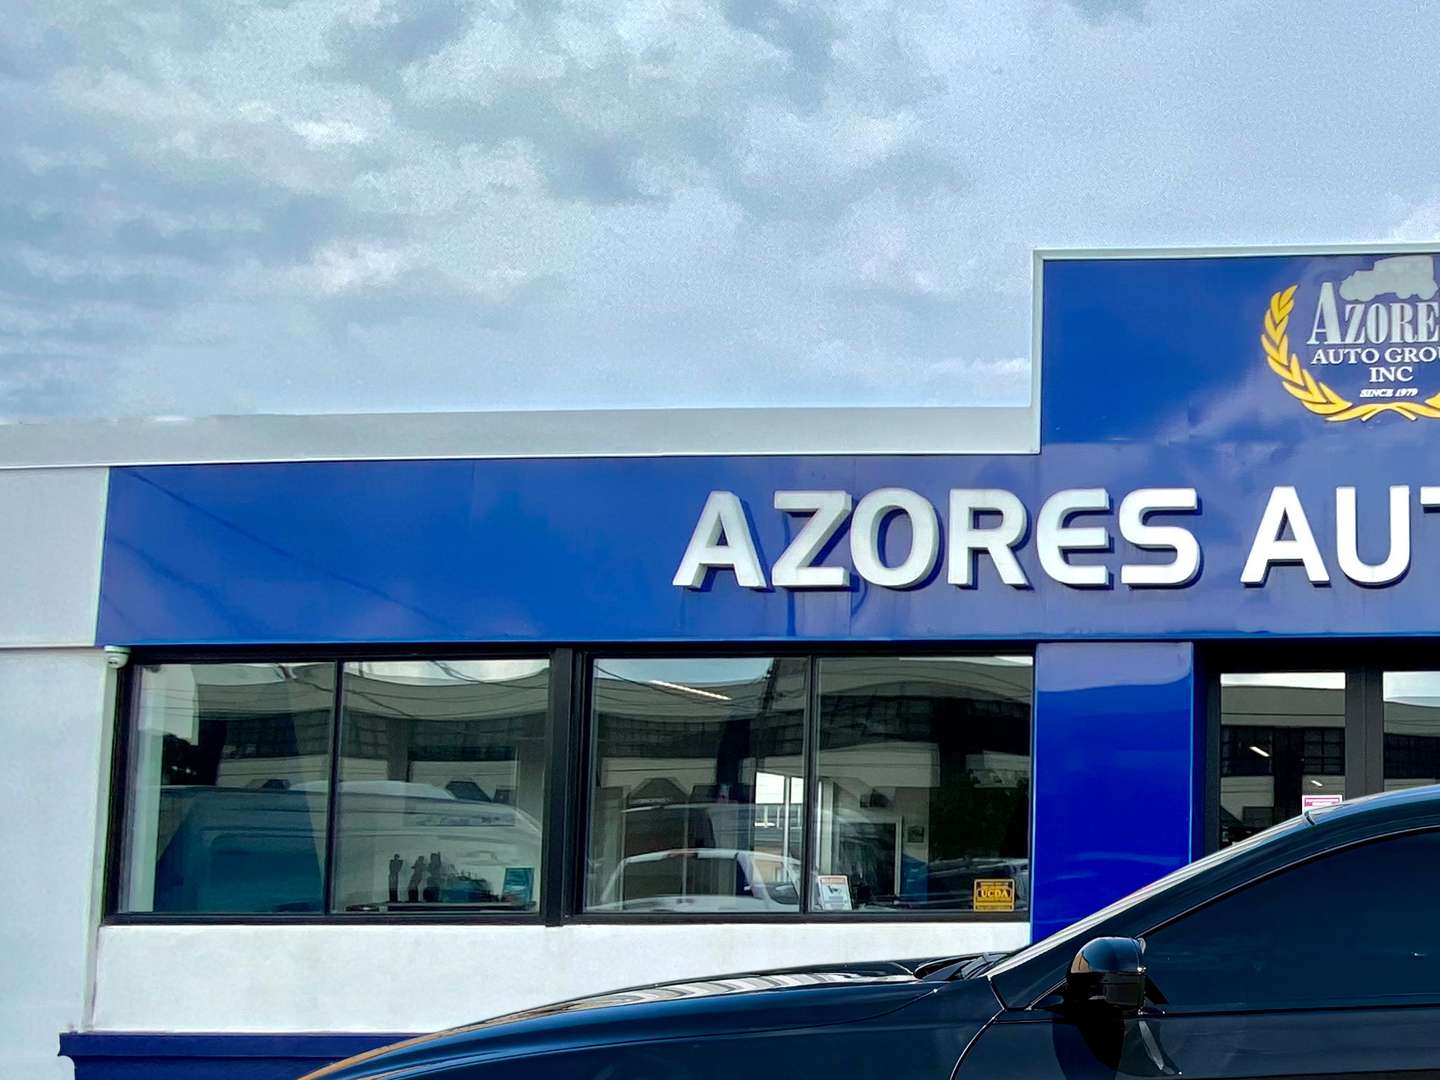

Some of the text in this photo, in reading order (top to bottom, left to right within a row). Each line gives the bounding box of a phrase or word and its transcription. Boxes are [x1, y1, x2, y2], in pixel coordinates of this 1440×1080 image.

[1311, 348, 1379, 366] AUTO
[1368, 366, 1414, 383] INC
[1360, 387, 1418, 398] SINCE 1979
[672, 487, 1201, 592] AZORES
[980, 889, 1009, 898] UCDA
